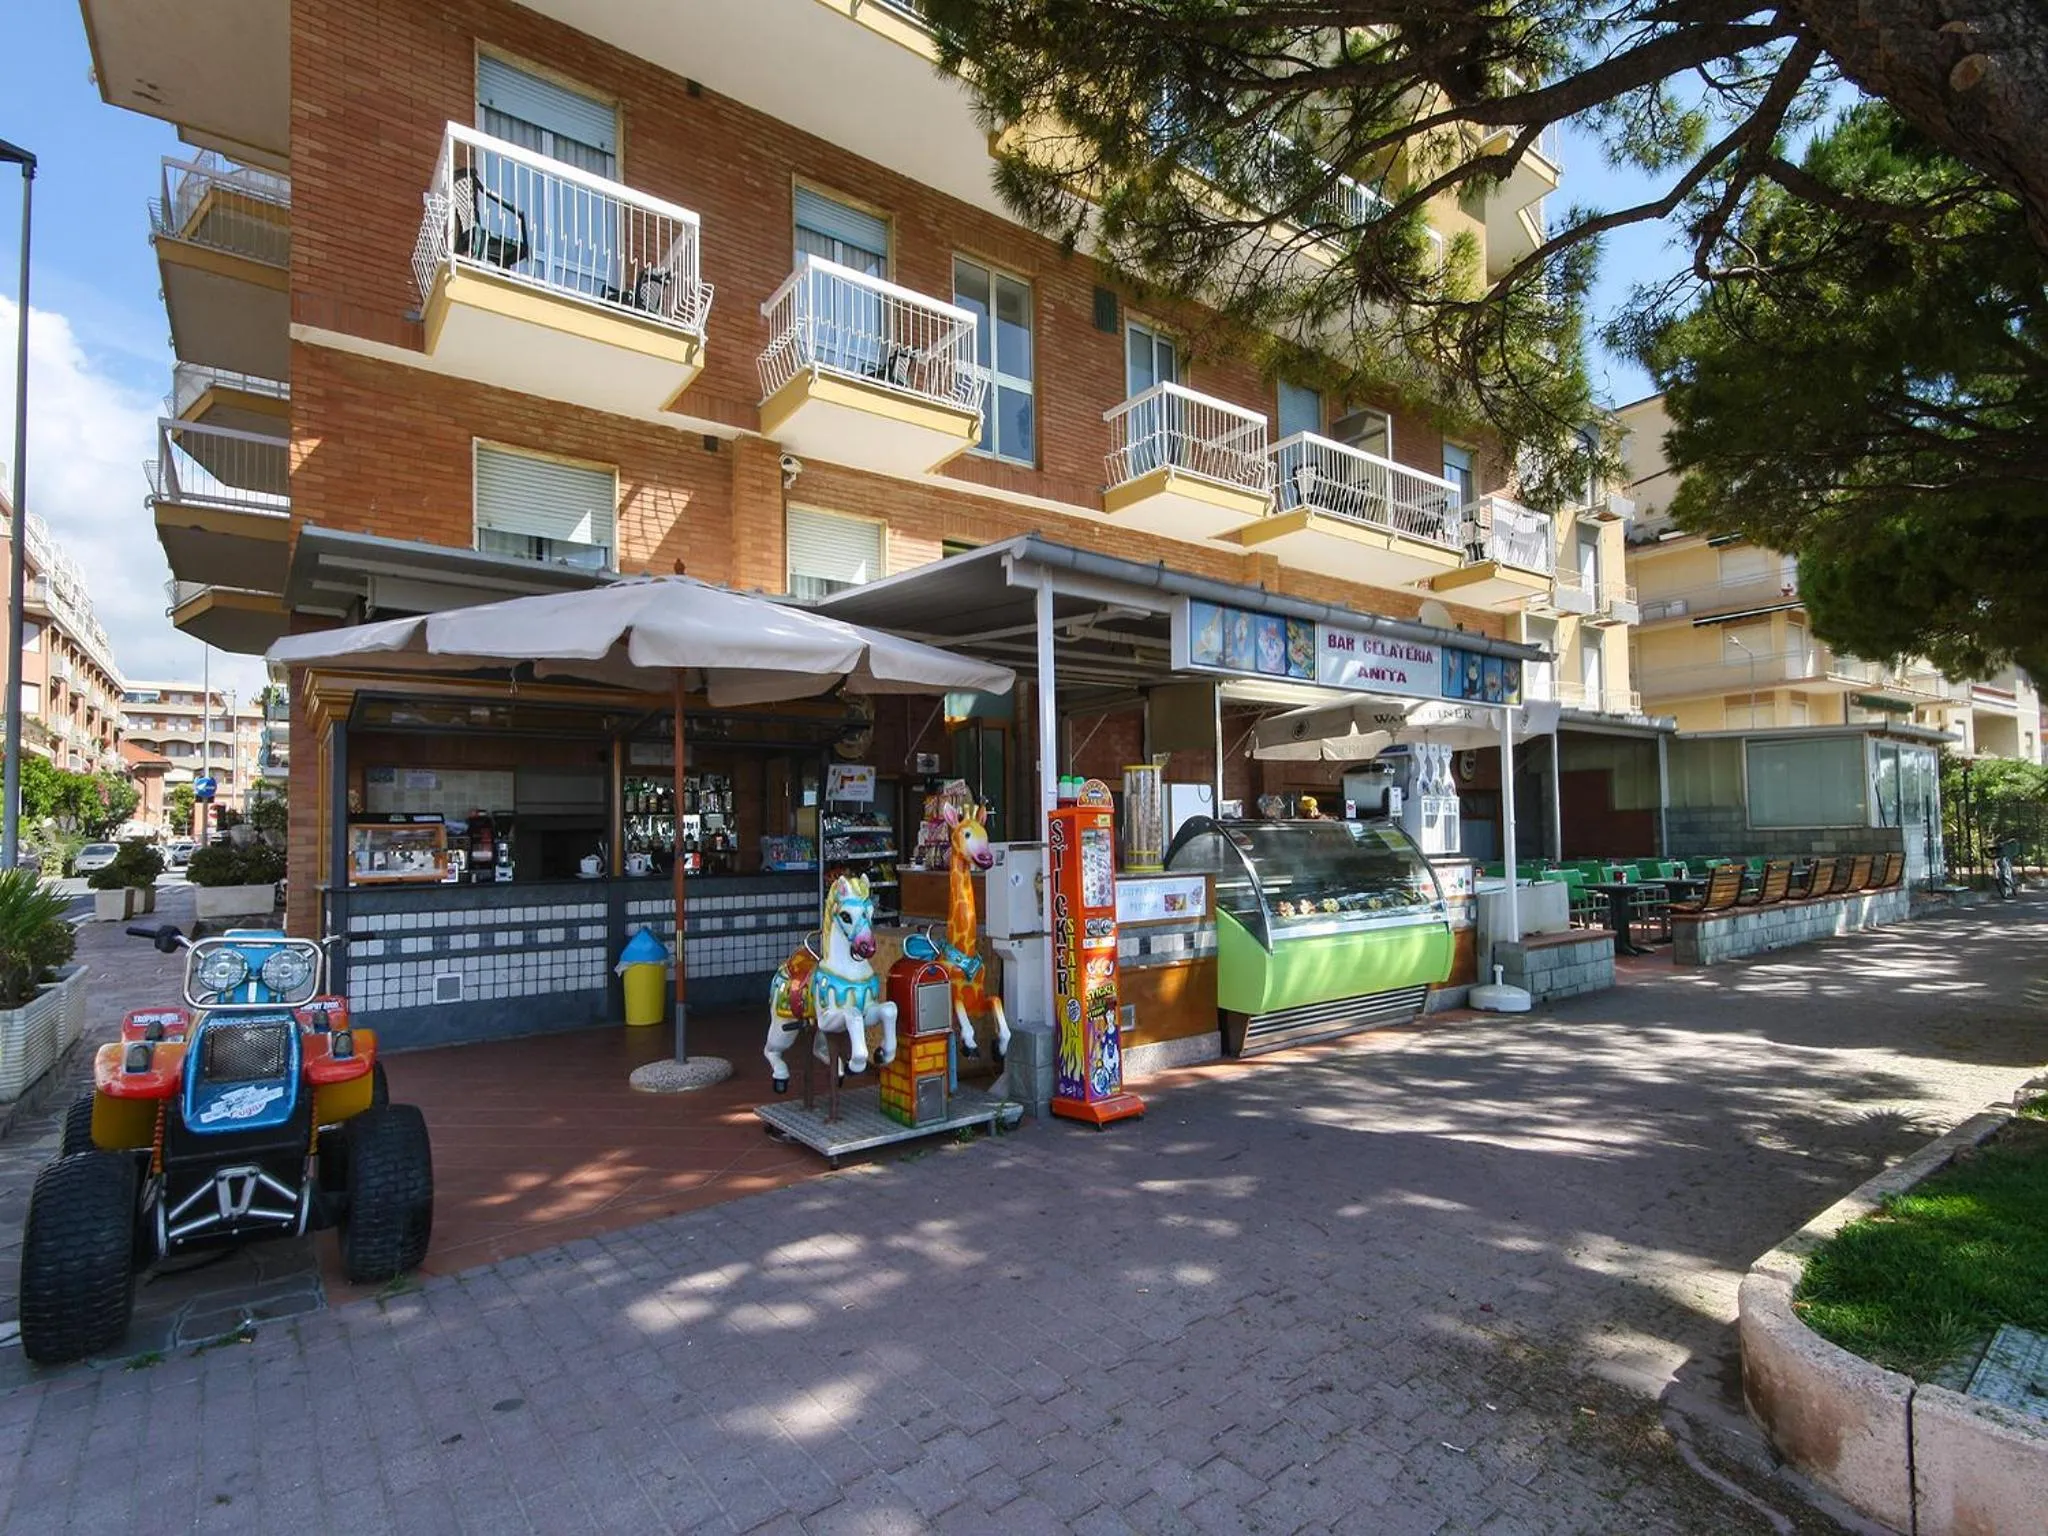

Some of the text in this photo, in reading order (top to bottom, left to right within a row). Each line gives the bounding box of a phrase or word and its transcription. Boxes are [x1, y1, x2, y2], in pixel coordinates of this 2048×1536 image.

[1327, 633, 1434, 664] BAR GELATERIA
[1357, 665, 1408, 684] ANITA
[1050, 819, 1070, 997] STICKER
